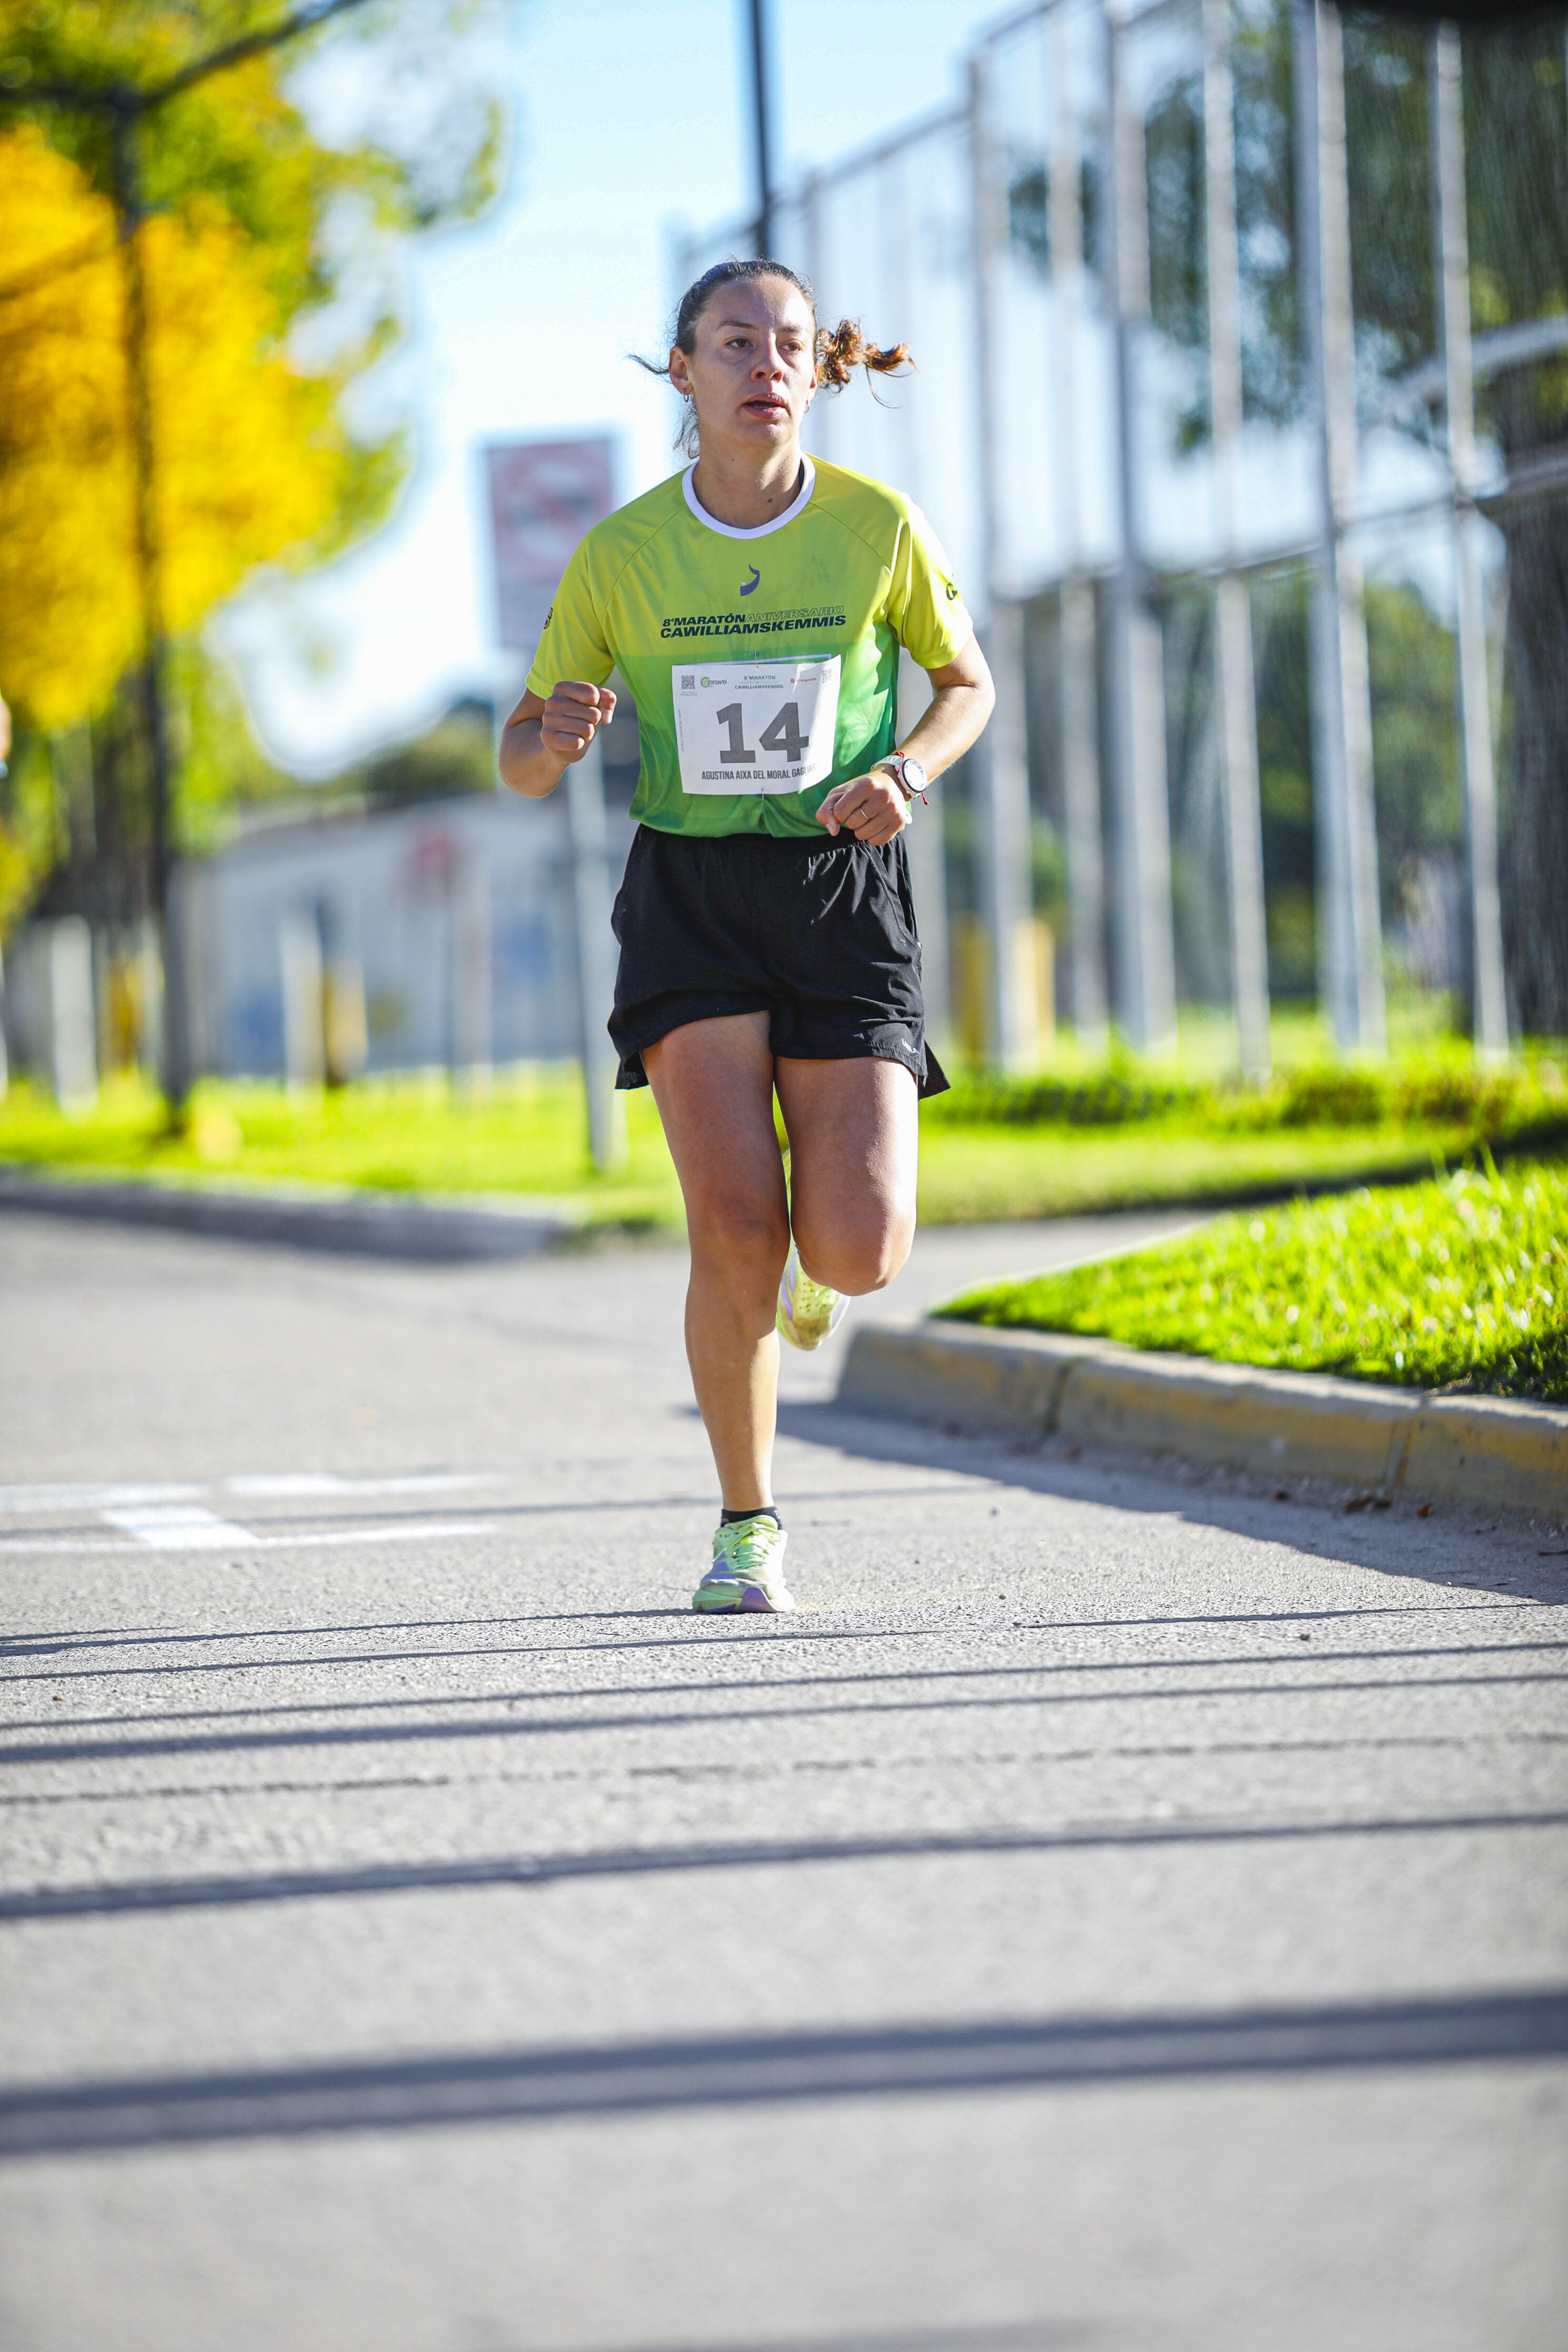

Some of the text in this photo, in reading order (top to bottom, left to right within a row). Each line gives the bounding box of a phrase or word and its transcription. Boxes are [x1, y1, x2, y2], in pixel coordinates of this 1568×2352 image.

[660, 615, 846, 638] CAWILLIAMSKEMMIS
[717, 702, 809, 763] 14
[702, 771, 734, 780] AGUSTINA
[736, 770, 752, 780] AIXA
[753, 770, 766, 779] DEL
[767, 769, 790, 779] MORAL
